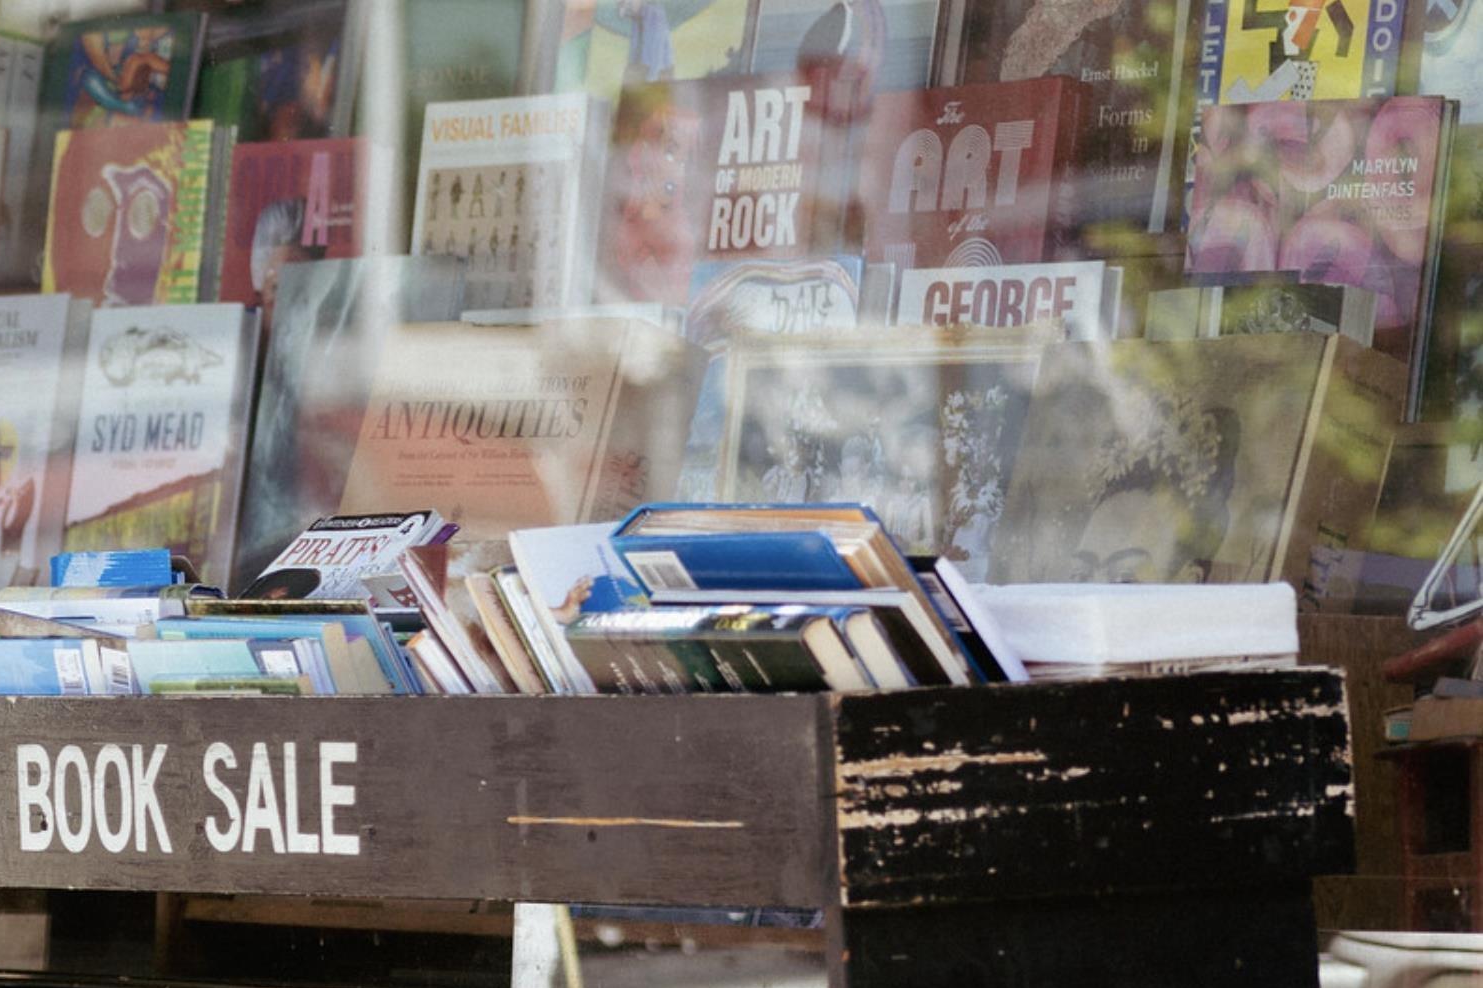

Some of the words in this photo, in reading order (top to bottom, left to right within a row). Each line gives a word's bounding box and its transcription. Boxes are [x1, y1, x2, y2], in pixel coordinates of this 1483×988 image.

[1081, 66, 1111, 83] Ernst
[718, 86, 811, 166] ART
[936, 101, 965, 126] The
[1098, 105, 1153, 128] Forms
[431, 114, 494, 143] VISUAL
[1131, 134, 1148, 153] in
[716, 169, 736, 193] OF
[737, 163, 803, 192] MODERN
[888, 120, 1035, 214] ART
[1352, 156, 1418, 175] MARYLYN
[1327, 182, 1415, 200] DINTENFASS
[708, 192, 800, 250] ROCK
[91, 412, 138, 453] SYD
[143, 411, 205, 451] MEAD
[368, 398, 589, 446] ANTIQUITIES
[16, 741, 173, 854] BOOK
[202, 740, 362, 856] SALE
